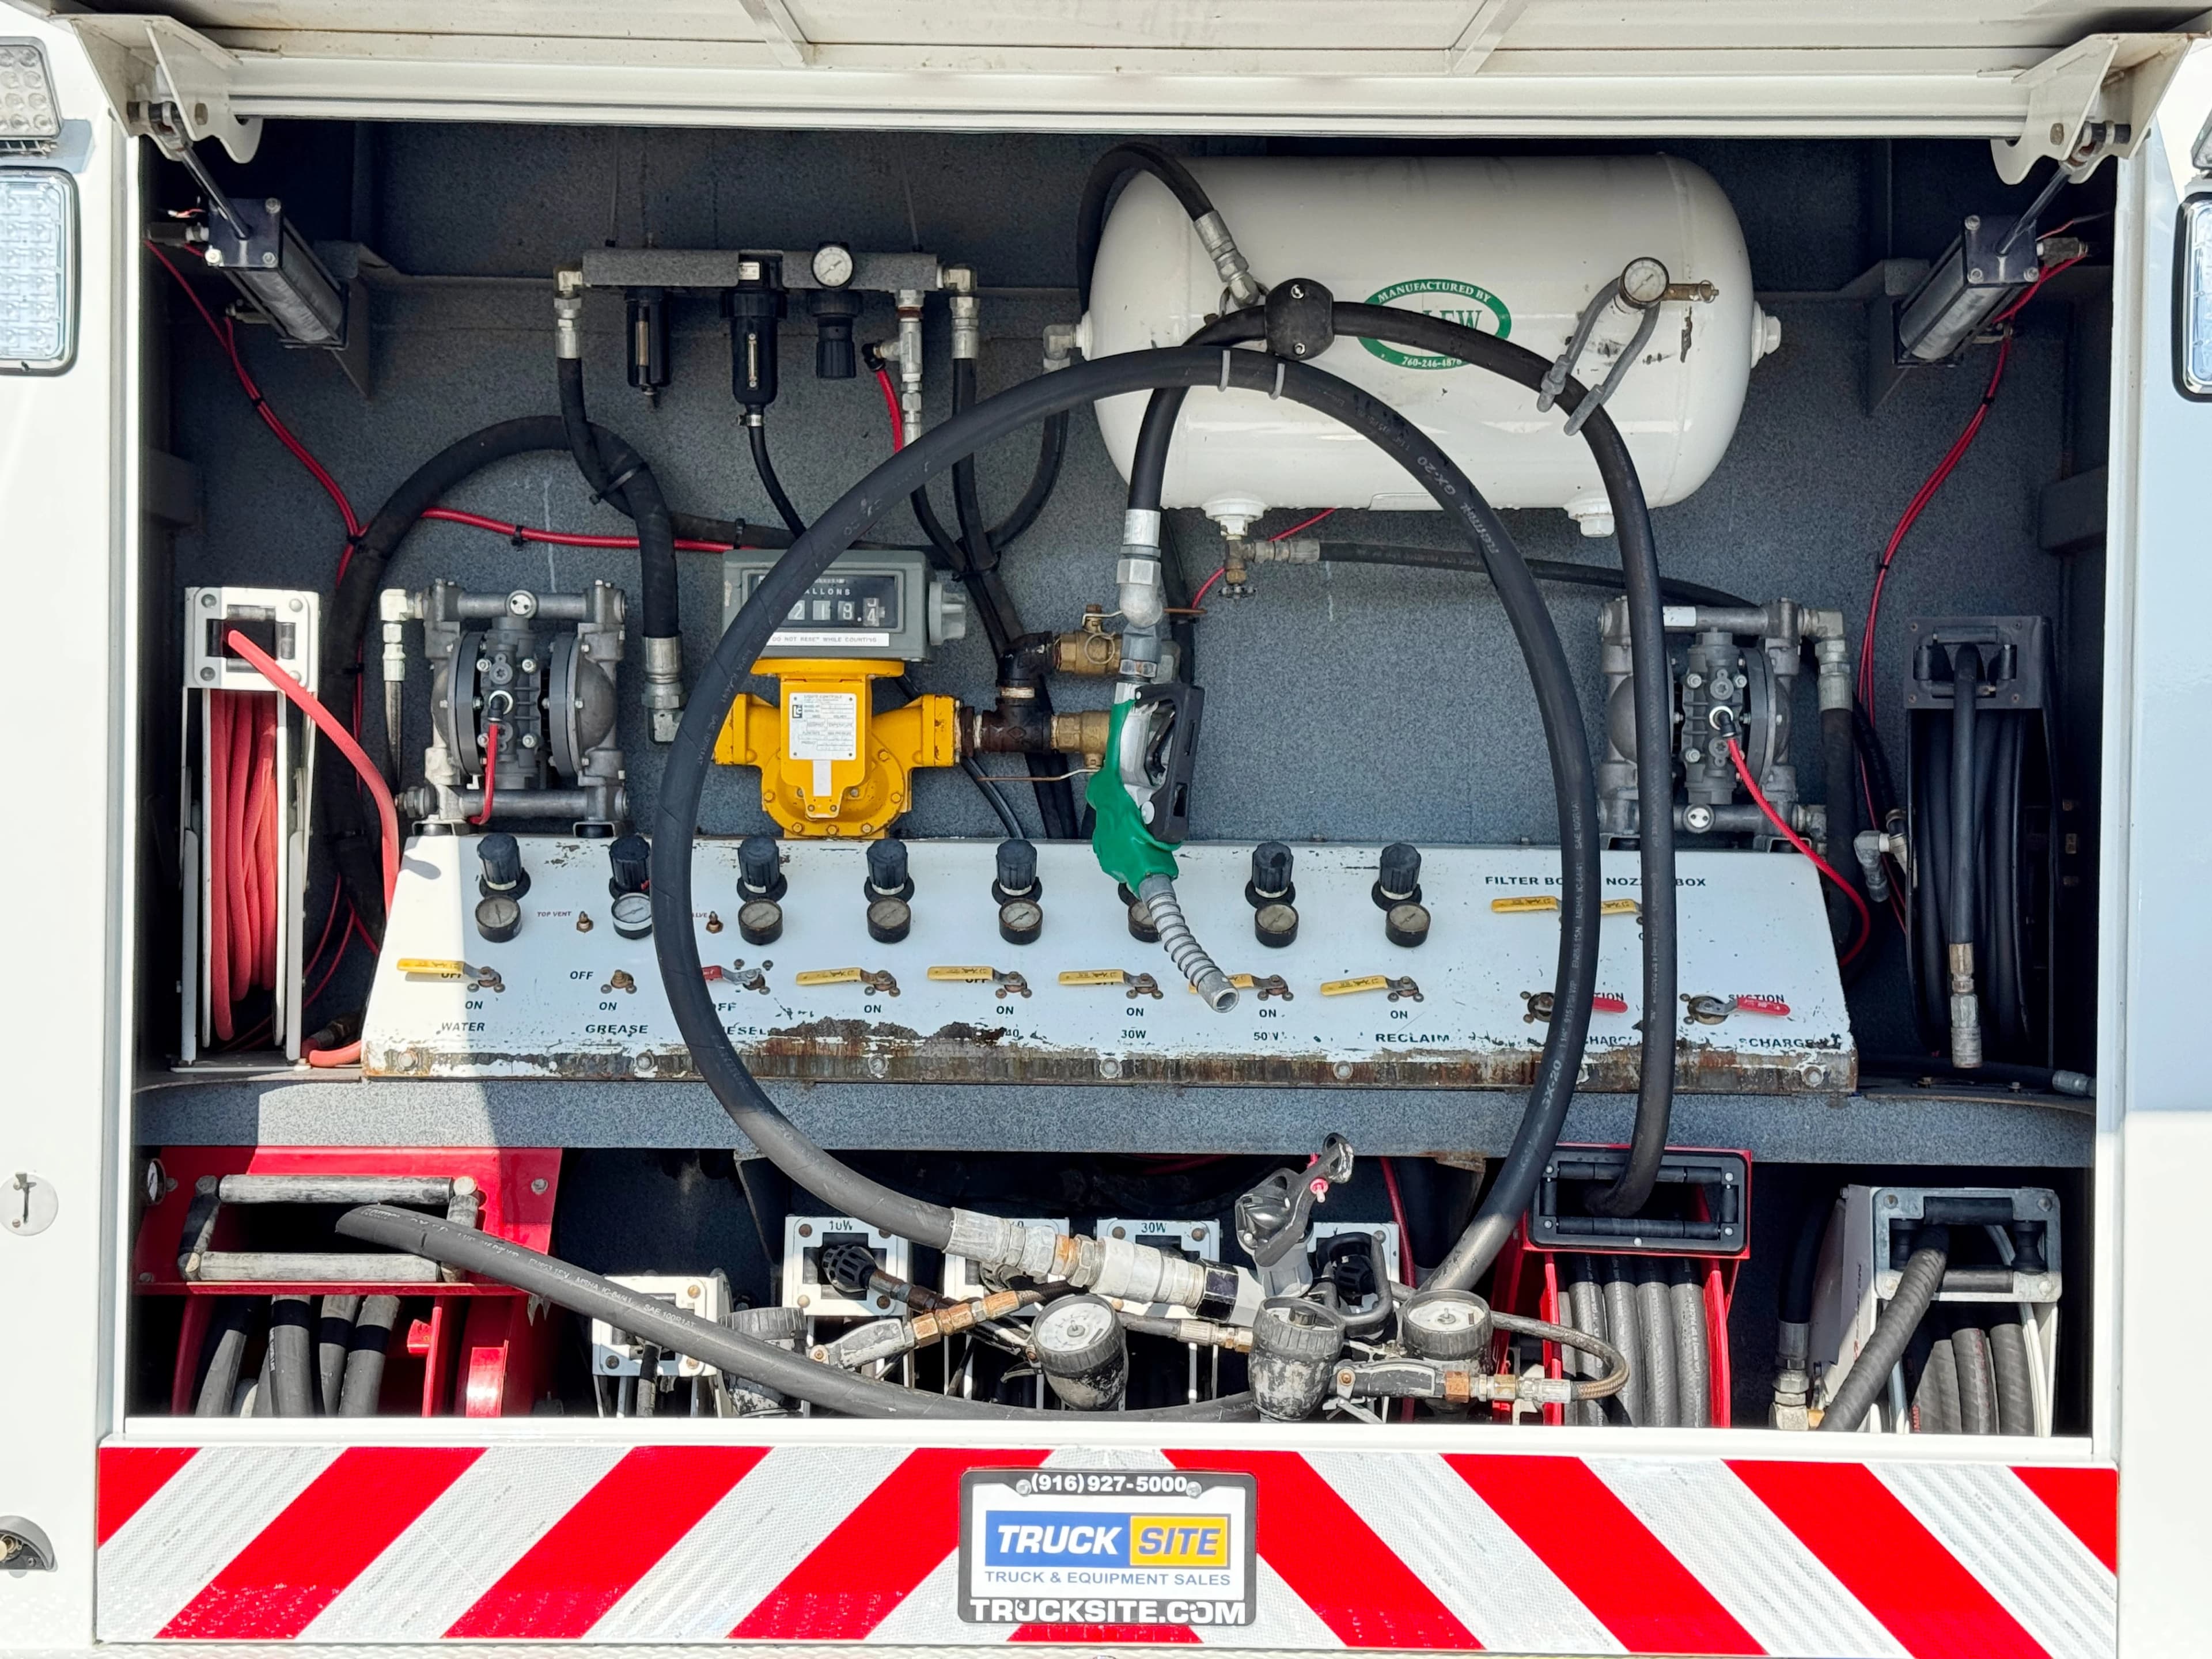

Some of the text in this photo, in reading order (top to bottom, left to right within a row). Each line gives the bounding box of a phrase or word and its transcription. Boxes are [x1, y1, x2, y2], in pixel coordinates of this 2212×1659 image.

[1378, 281, 1491, 303] MANUFACTURED BY
[804, 588, 851, 596] ALLONS
[1485, 877, 1563, 885] FILTER BO
[1606, 877, 1706, 887] NOZ BOX
[570, 971, 594, 980] OFF
[465, 1001, 483, 1010] ON
[599, 1002, 618, 1011] ON
[713, 1002, 737, 1012] FF
[863, 1004, 882, 1013] ON
[996, 1005, 1014, 1015] ON
[1126, 1007, 1145, 1017] ON
[1259, 1009, 1277, 1018] ON
[1390, 1010, 1408, 1019] ON
[441, 1022, 486, 1032] WATER
[585, 1024, 649, 1035] GREASE
[724, 1025, 767, 1035] ESEL
[1121, 1029, 1147, 1039] 30W
[1375, 1032, 1450, 1043] RECLAIM
[1141, 1222, 1168, 1233] 30W
[643, 1304, 661, 1316] SAE
[997, 1525, 1222, 1555] TRUCK SITE
[985, 1571, 1231, 1586] TRUCK & EQUIPMENT SALES
[969, 1598, 1246, 1625] TRUCKSITE.COM
